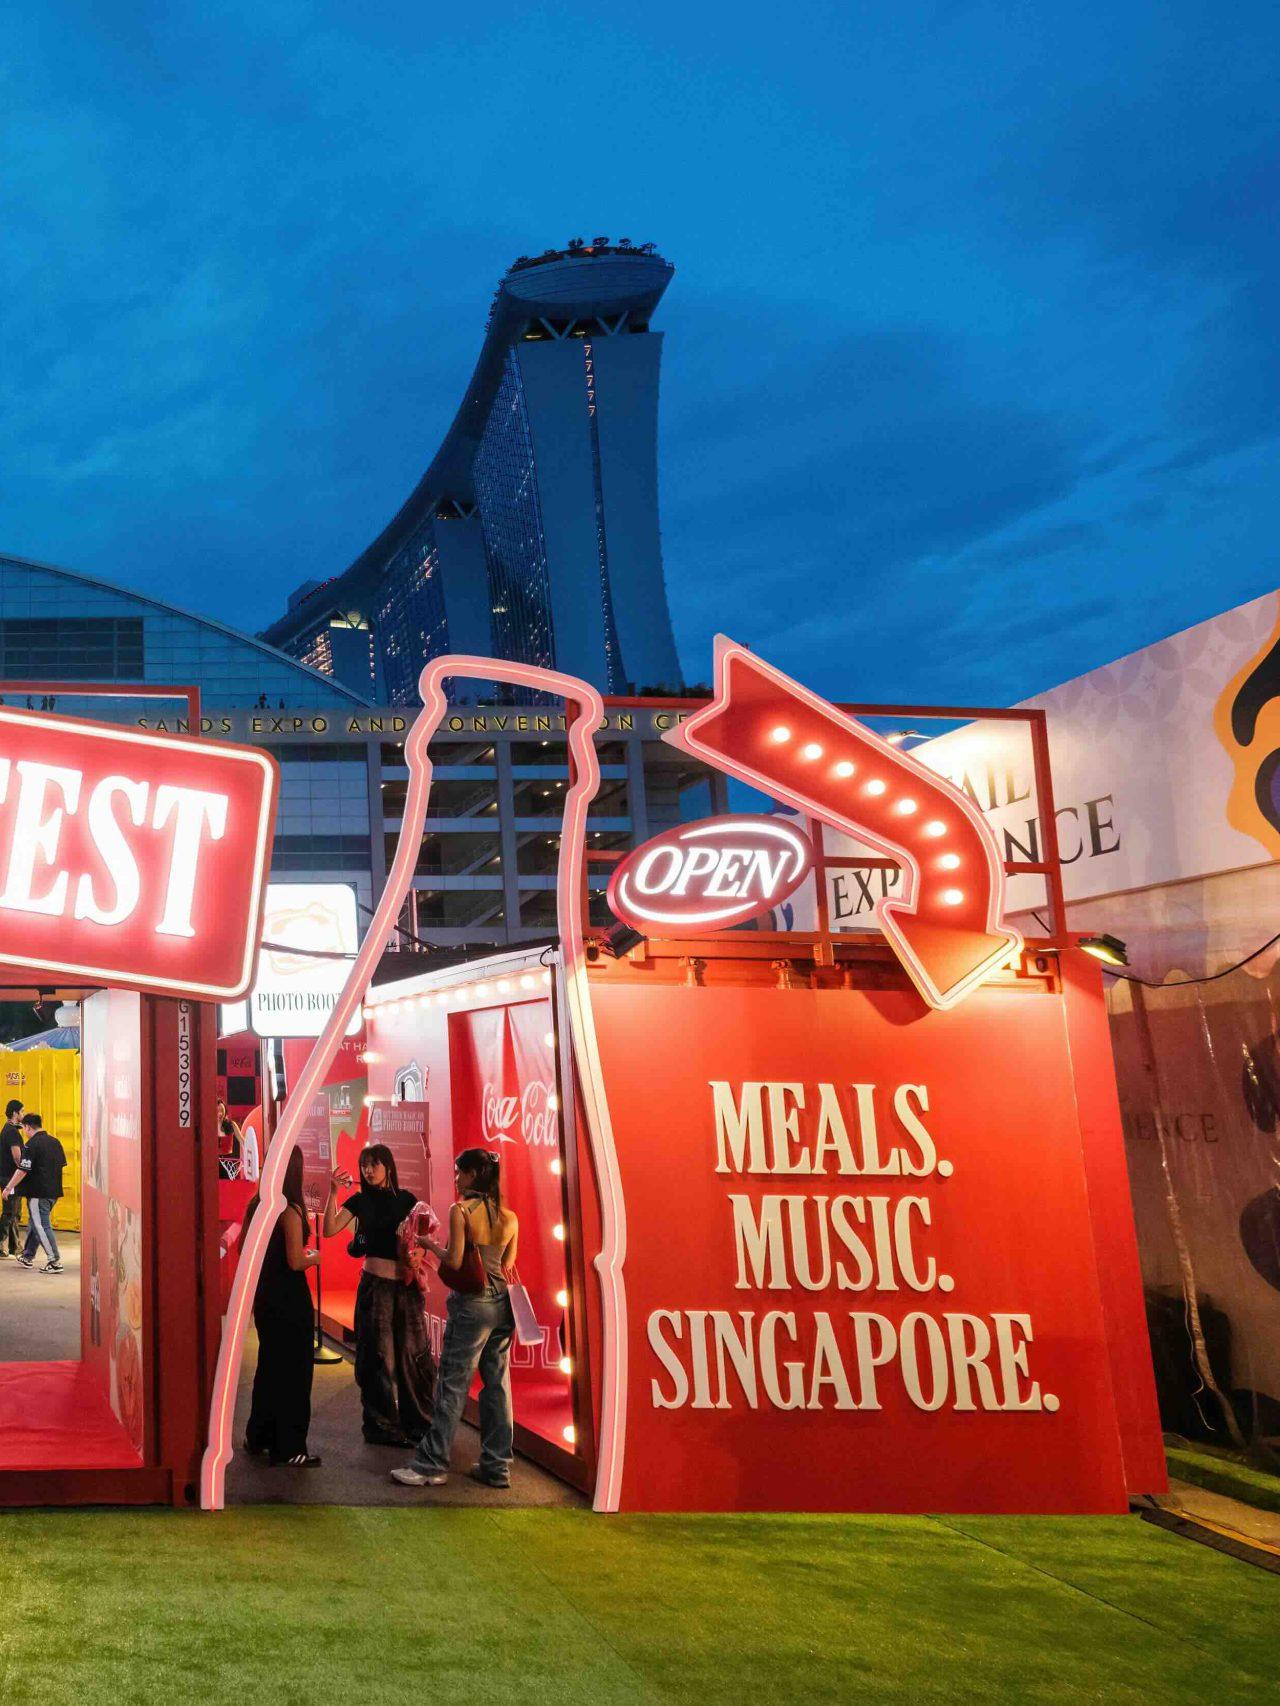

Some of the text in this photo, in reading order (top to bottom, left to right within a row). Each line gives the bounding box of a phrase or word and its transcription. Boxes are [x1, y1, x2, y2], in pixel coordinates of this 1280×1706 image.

[137, 717, 232, 733] SANDS
[252, 717, 328, 733] EXPO
[349, 717, 406, 733] AND
[447, 714, 634, 732] ONVENTON
[635, 845, 793, 899] OPEN
[258, 992, 343, 1012] PHOTO BOO
[708, 1081, 954, 1177] MEALS.
[728, 1194, 955, 1292] MUSIC.
[646, 1310, 1061, 1413] SINGAPORE.
